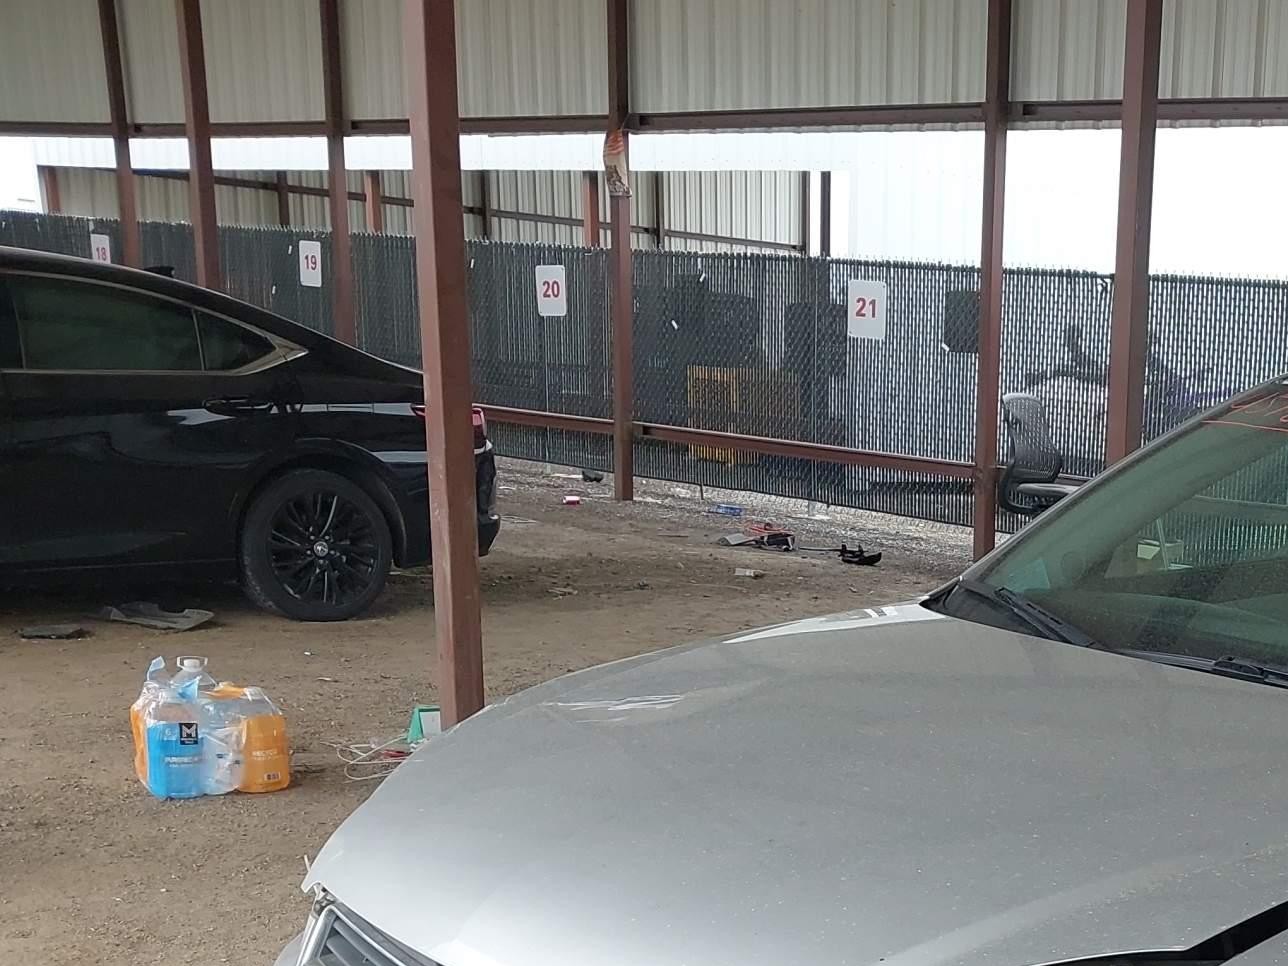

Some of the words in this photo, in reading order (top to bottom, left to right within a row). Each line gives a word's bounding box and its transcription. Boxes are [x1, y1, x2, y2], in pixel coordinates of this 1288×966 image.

[96, 247, 107, 261] 18
[304, 254, 317, 271] 19
[542, 280, 560, 298] 20
[855, 297, 877, 319] 21
